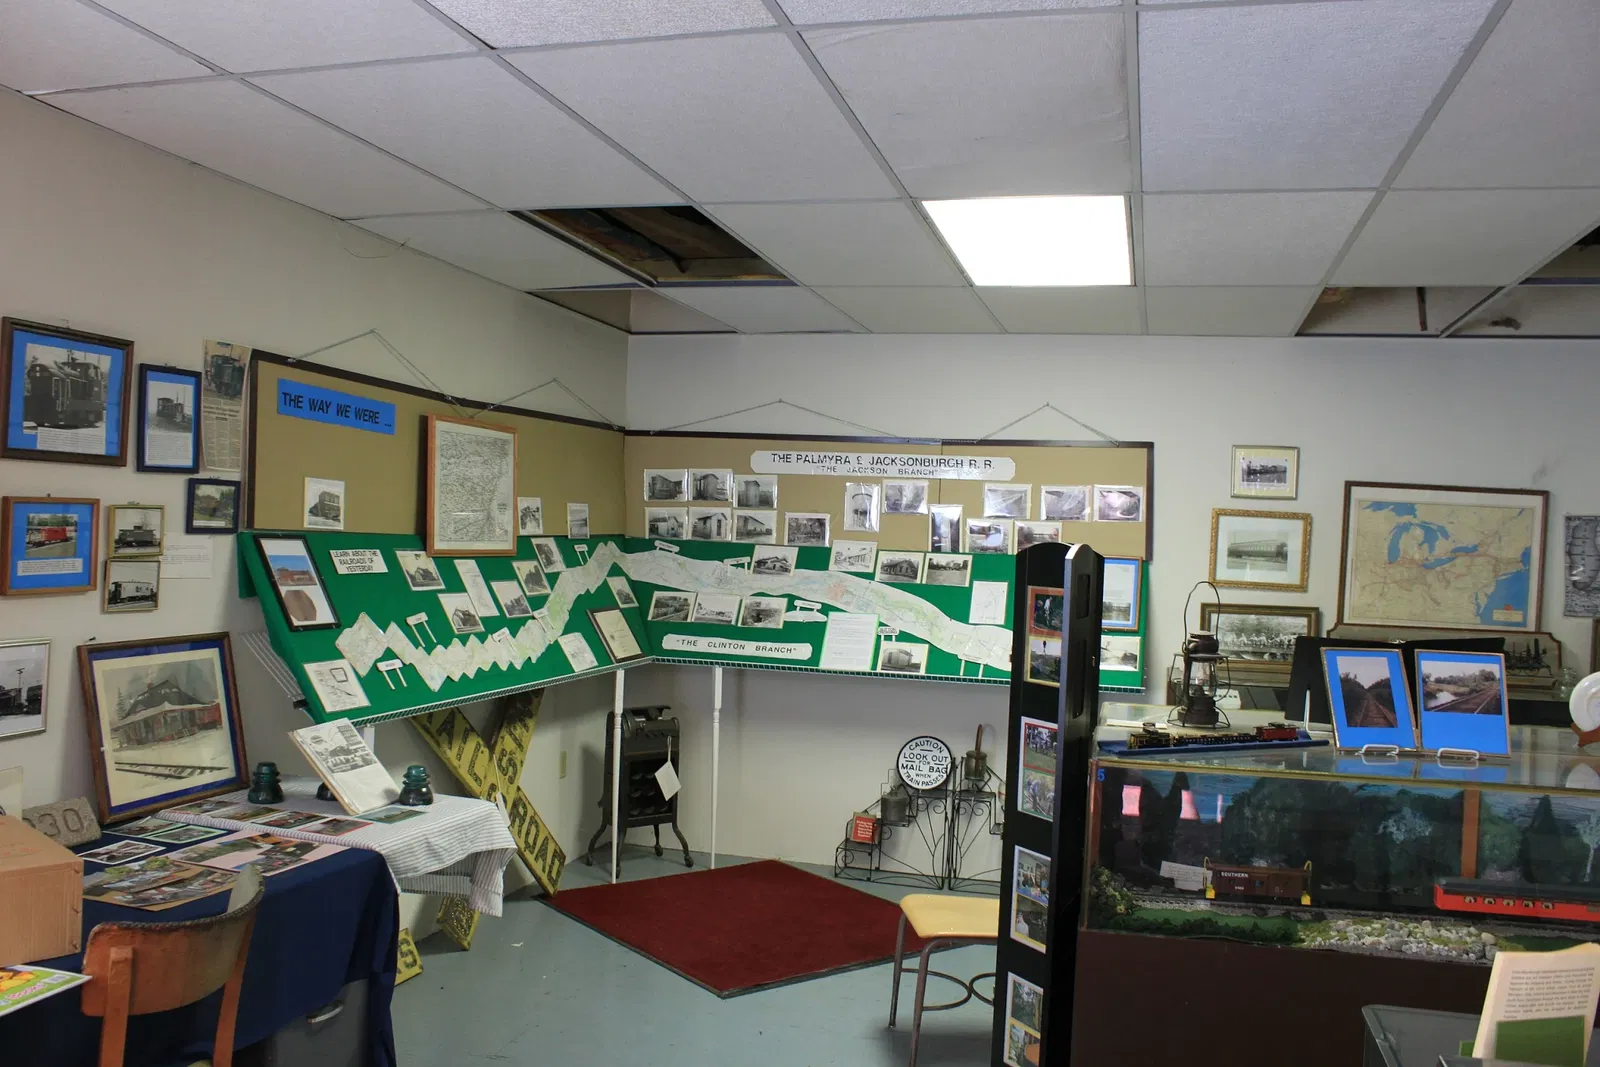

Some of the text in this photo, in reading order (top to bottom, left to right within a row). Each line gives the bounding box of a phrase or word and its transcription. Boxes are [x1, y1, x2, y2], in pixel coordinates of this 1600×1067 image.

[282, 391, 304, 409] THE
[308, 397, 332, 415] WAY
[336, 402, 352, 419] WE
[354, 406, 380, 424] WERE
[771, 453, 792, 464] THE
[795, 454, 852, 465] PALMYRA
[868, 456, 964, 469] JACKSONBURGH
[968, 459, 980, 469] R.
[984, 459, 996, 469] R.
[846, 466, 888, 475] JACKSON
[338, 557, 367, 565] RAILROADS
[707, 641, 746, 651] CLINTON
[909, 740, 944, 753] CAUTION
[903, 752, 928, 760] LOOK
[901, 763, 947, 774] MAIL BAG
[1097, 767, 1105, 782] 5
[904, 770, 944, 786] TRAIN PASSES
